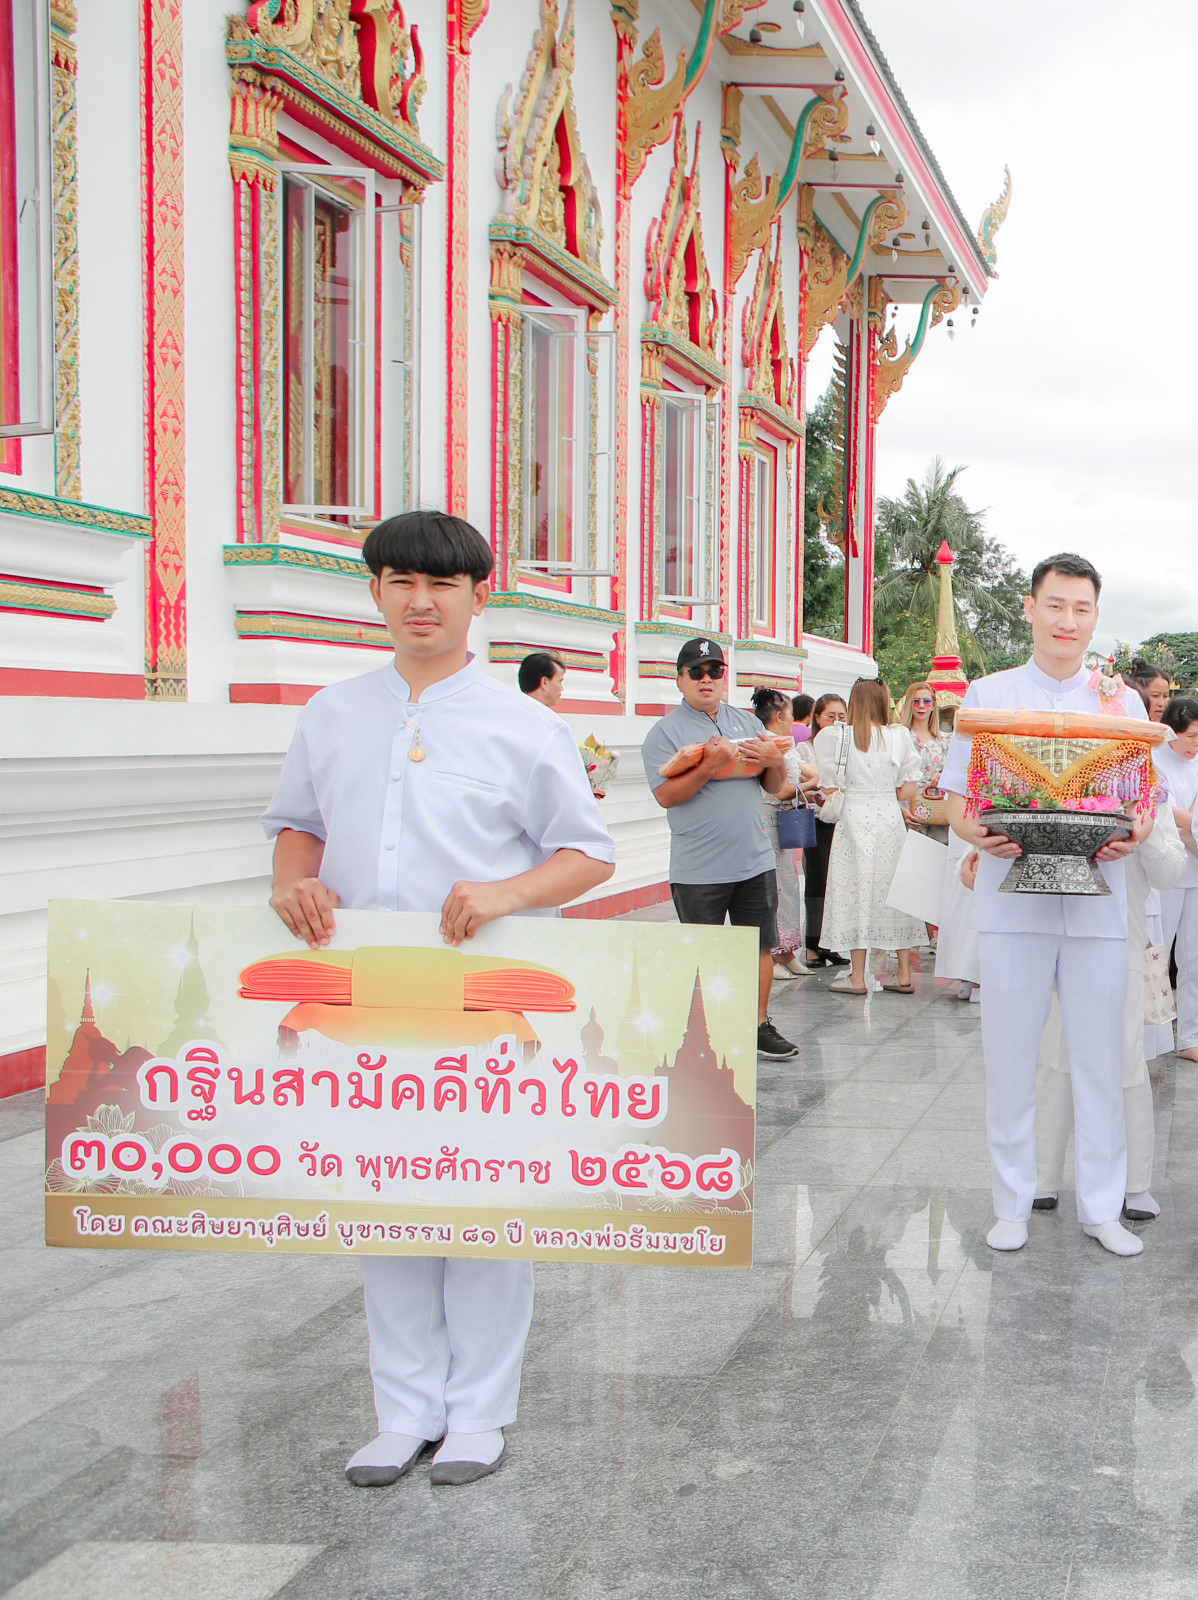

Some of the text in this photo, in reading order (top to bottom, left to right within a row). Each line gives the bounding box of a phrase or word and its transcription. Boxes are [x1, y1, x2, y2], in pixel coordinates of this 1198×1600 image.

[146, 1042, 659, 1121] กฐินสามัคคีทั่วไทย
[71, 1141, 733, 1192] ๓๐,๐๐๐ วัด พุทธศักราช ๒๕๖๘
[76, 1209, 725, 1252] โดย คณะศิษยานุศิษย์ บูชาธรรม ๘๑ ปี หลวงพ่อธัมมชโย
